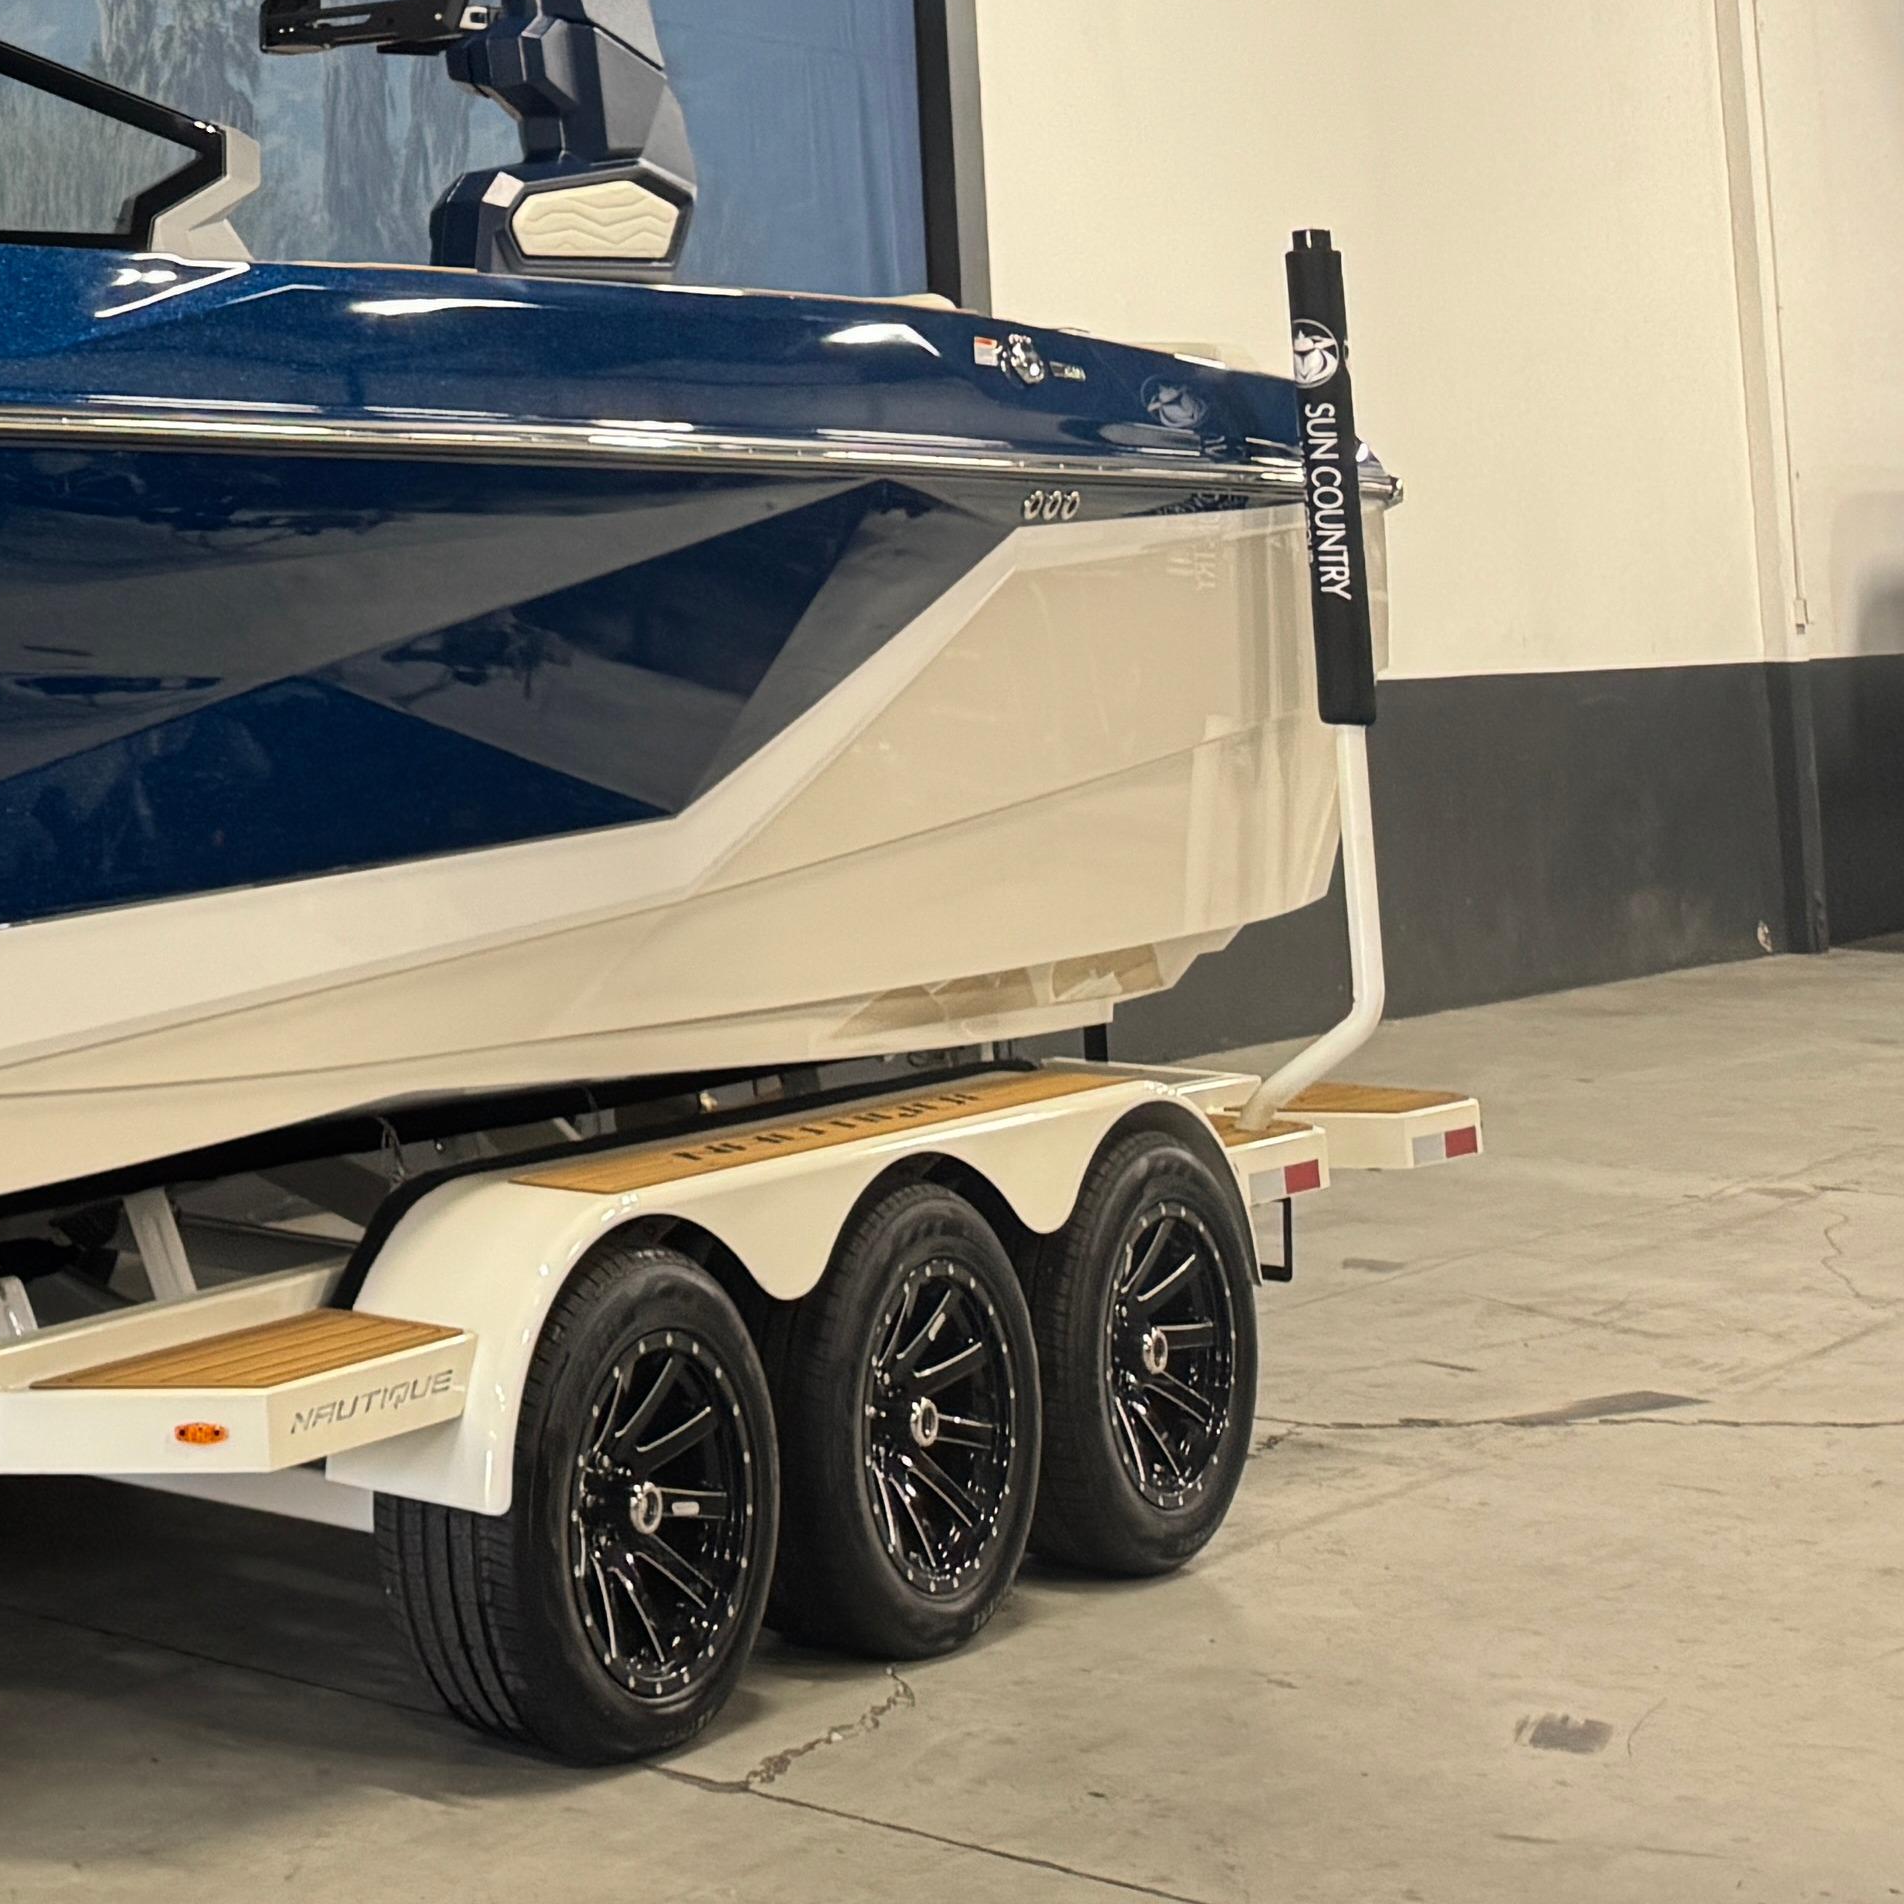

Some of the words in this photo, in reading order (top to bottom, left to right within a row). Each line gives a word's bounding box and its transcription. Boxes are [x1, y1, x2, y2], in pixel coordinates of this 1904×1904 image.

[1303, 402, 1340, 460] SUN
[1310, 465, 1353, 601] COUNTRY
[289, 1368, 454, 1435] NAUTIQUE
